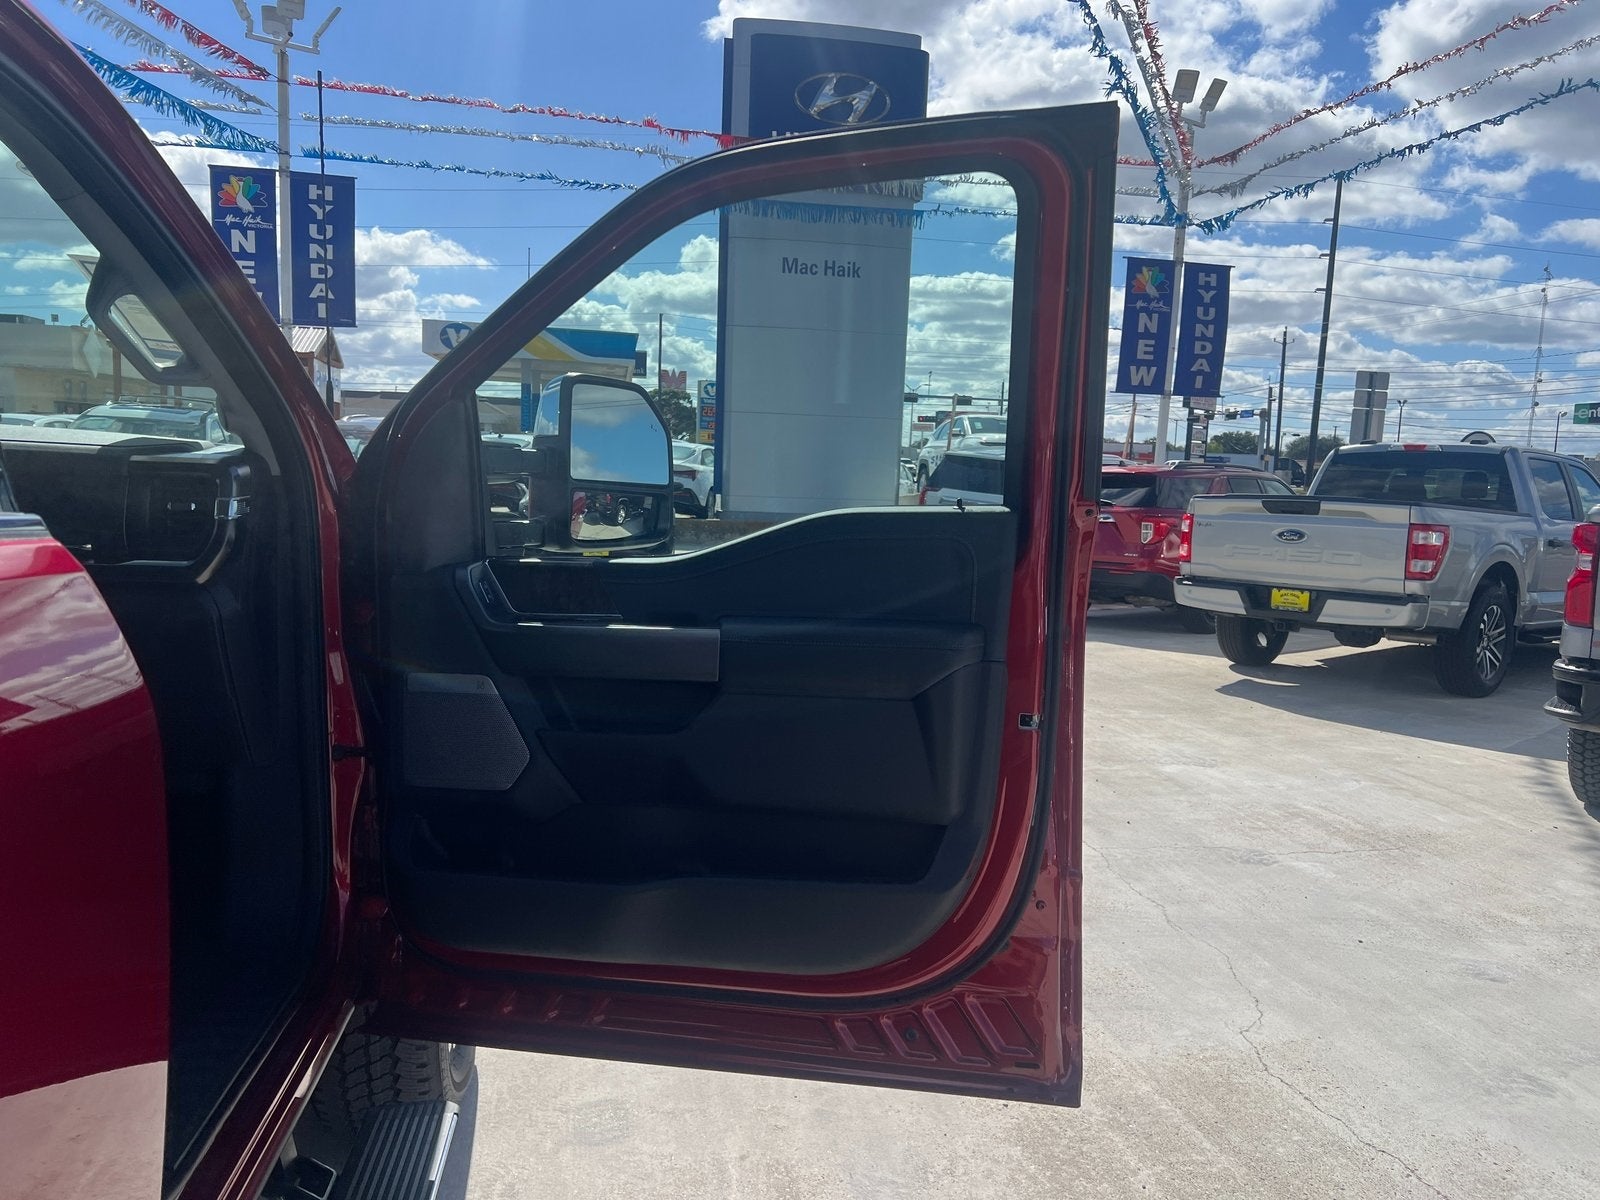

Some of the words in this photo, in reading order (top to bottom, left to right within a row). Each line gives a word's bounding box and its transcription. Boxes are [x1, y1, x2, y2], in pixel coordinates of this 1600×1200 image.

[231, 229, 263, 299] NE
[308, 184, 335, 318] HYUNDAI
[782, 257, 819, 276] Mac
[823, 259, 862, 279] Haik
[1129, 312, 1159, 387] NEW
[1190, 272, 1218, 389] HYUNDAI
[1224, 544, 1362, 567] F-150
[1281, 530, 1301, 541] Ford
